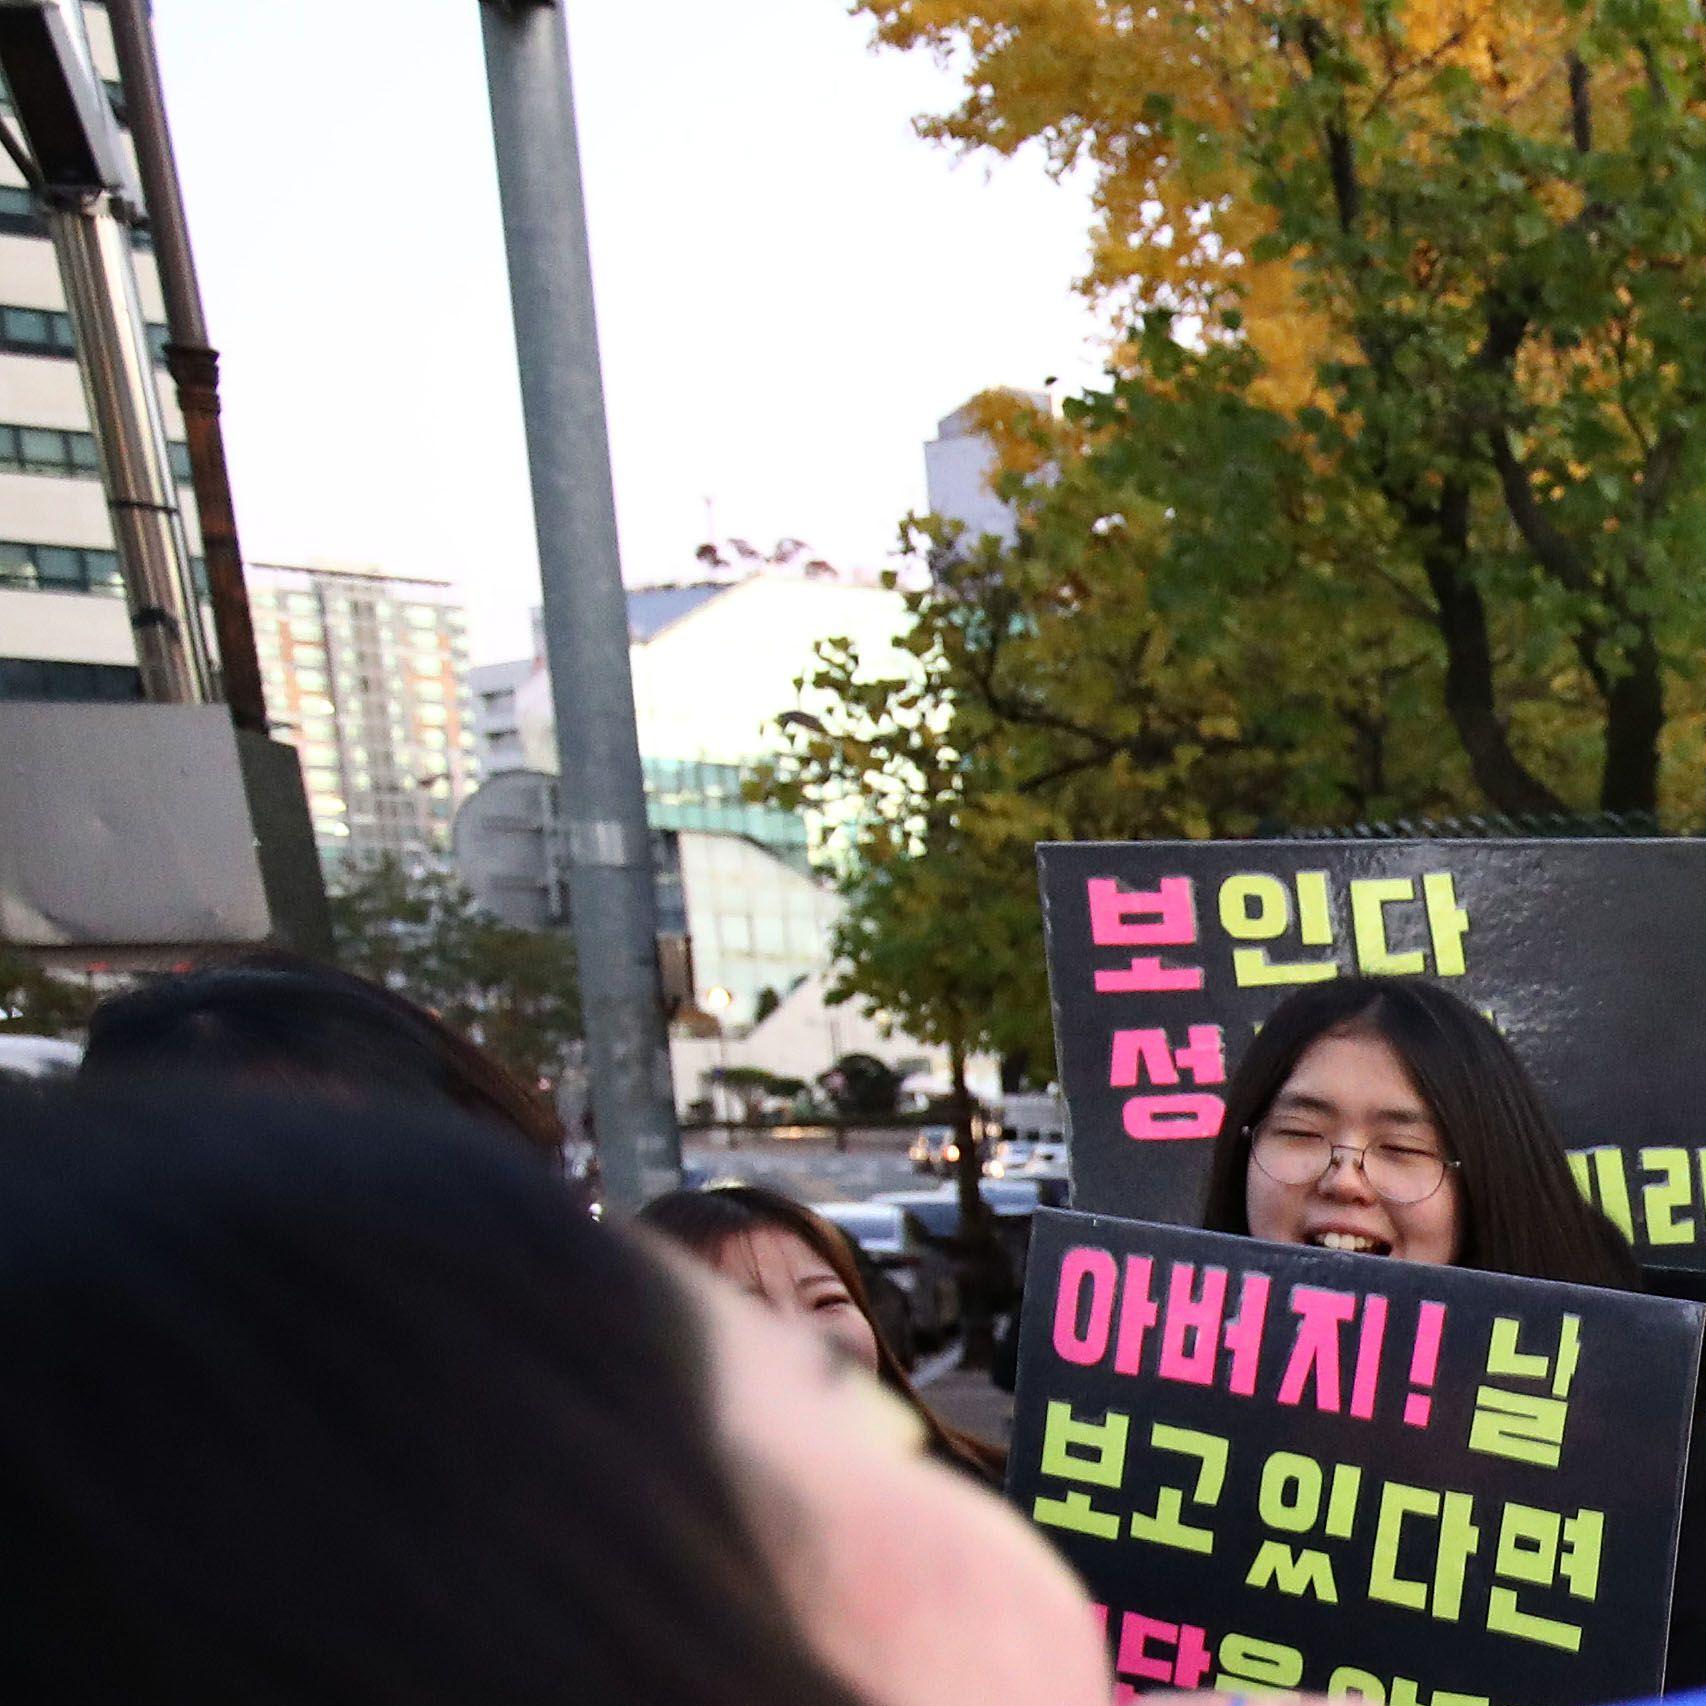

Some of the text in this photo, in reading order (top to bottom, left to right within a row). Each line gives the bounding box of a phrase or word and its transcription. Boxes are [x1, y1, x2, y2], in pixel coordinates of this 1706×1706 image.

[1052, 1246, 1581, 1470] 아버지! 날
[1032, 1400, 1605, 1653] 보고 있다면
